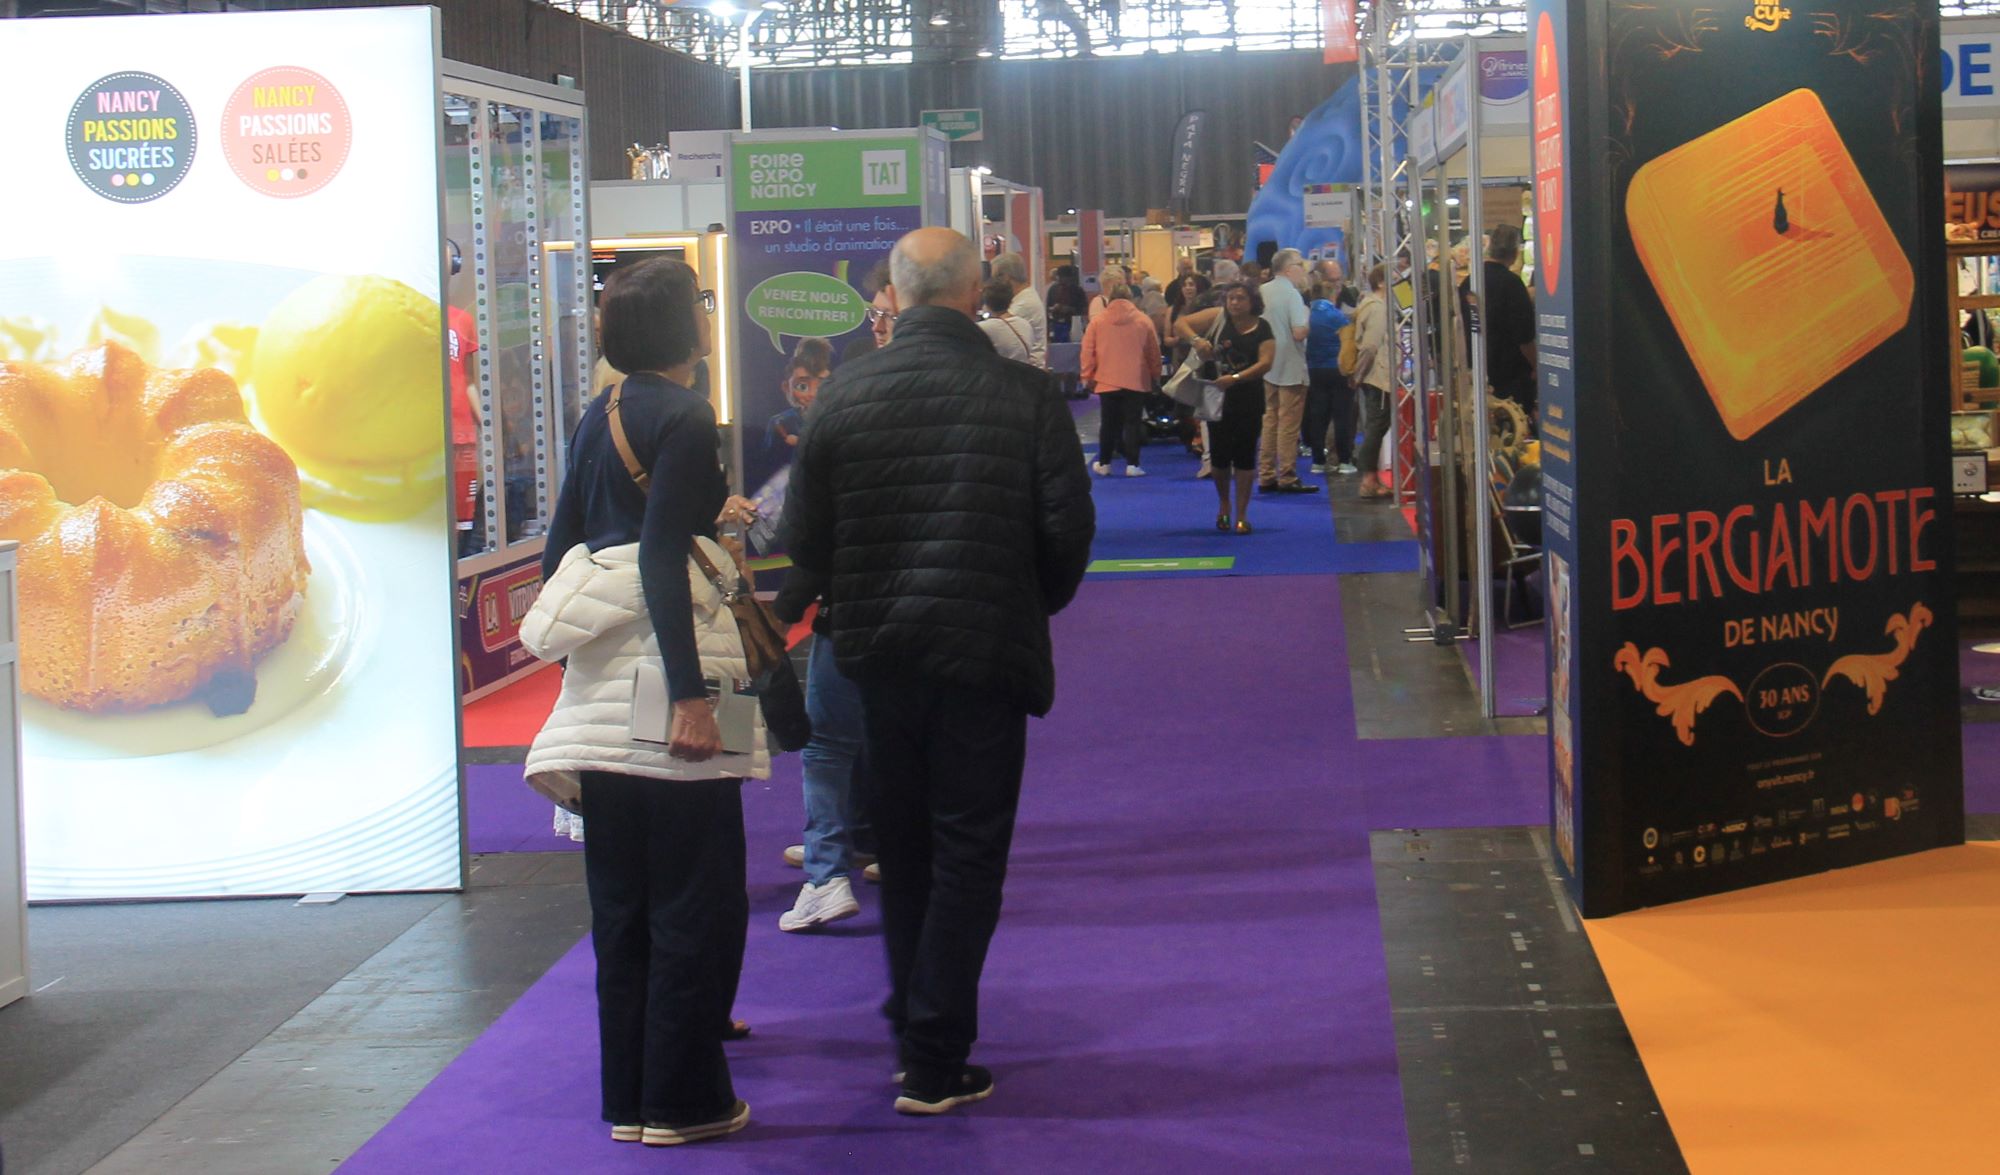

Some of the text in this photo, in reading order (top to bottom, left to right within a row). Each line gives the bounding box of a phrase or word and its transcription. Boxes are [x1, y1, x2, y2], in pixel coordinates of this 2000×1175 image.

[97, 90, 160, 113] NANCY
[253, 84, 316, 109] NANCY
[84, 118, 177, 142] PASSIONS
[239, 112, 333, 137] PASSIONS
[88, 142, 175, 170] SUCRÉES
[252, 138, 322, 164] SALÉES
[868, 162, 900, 186] TAT
[750, 219, 792, 235] EXPO
[815, 218, 842, 233] était
[846, 221, 871, 232] une
[764, 243, 781, 254] un
[785, 237, 820, 253] studio
[763, 288, 849, 305] VENEZ NOUS
[759, 306, 848, 322] RENCONTRER
[1764, 457, 1793, 486] LA
[1610, 487, 1936, 611] BERGAMOTE
[508, 576, 543, 625] VITRIN
[1724, 607, 1839, 648] DE NANCY
[1759, 684, 1810, 709] 30 ANS
